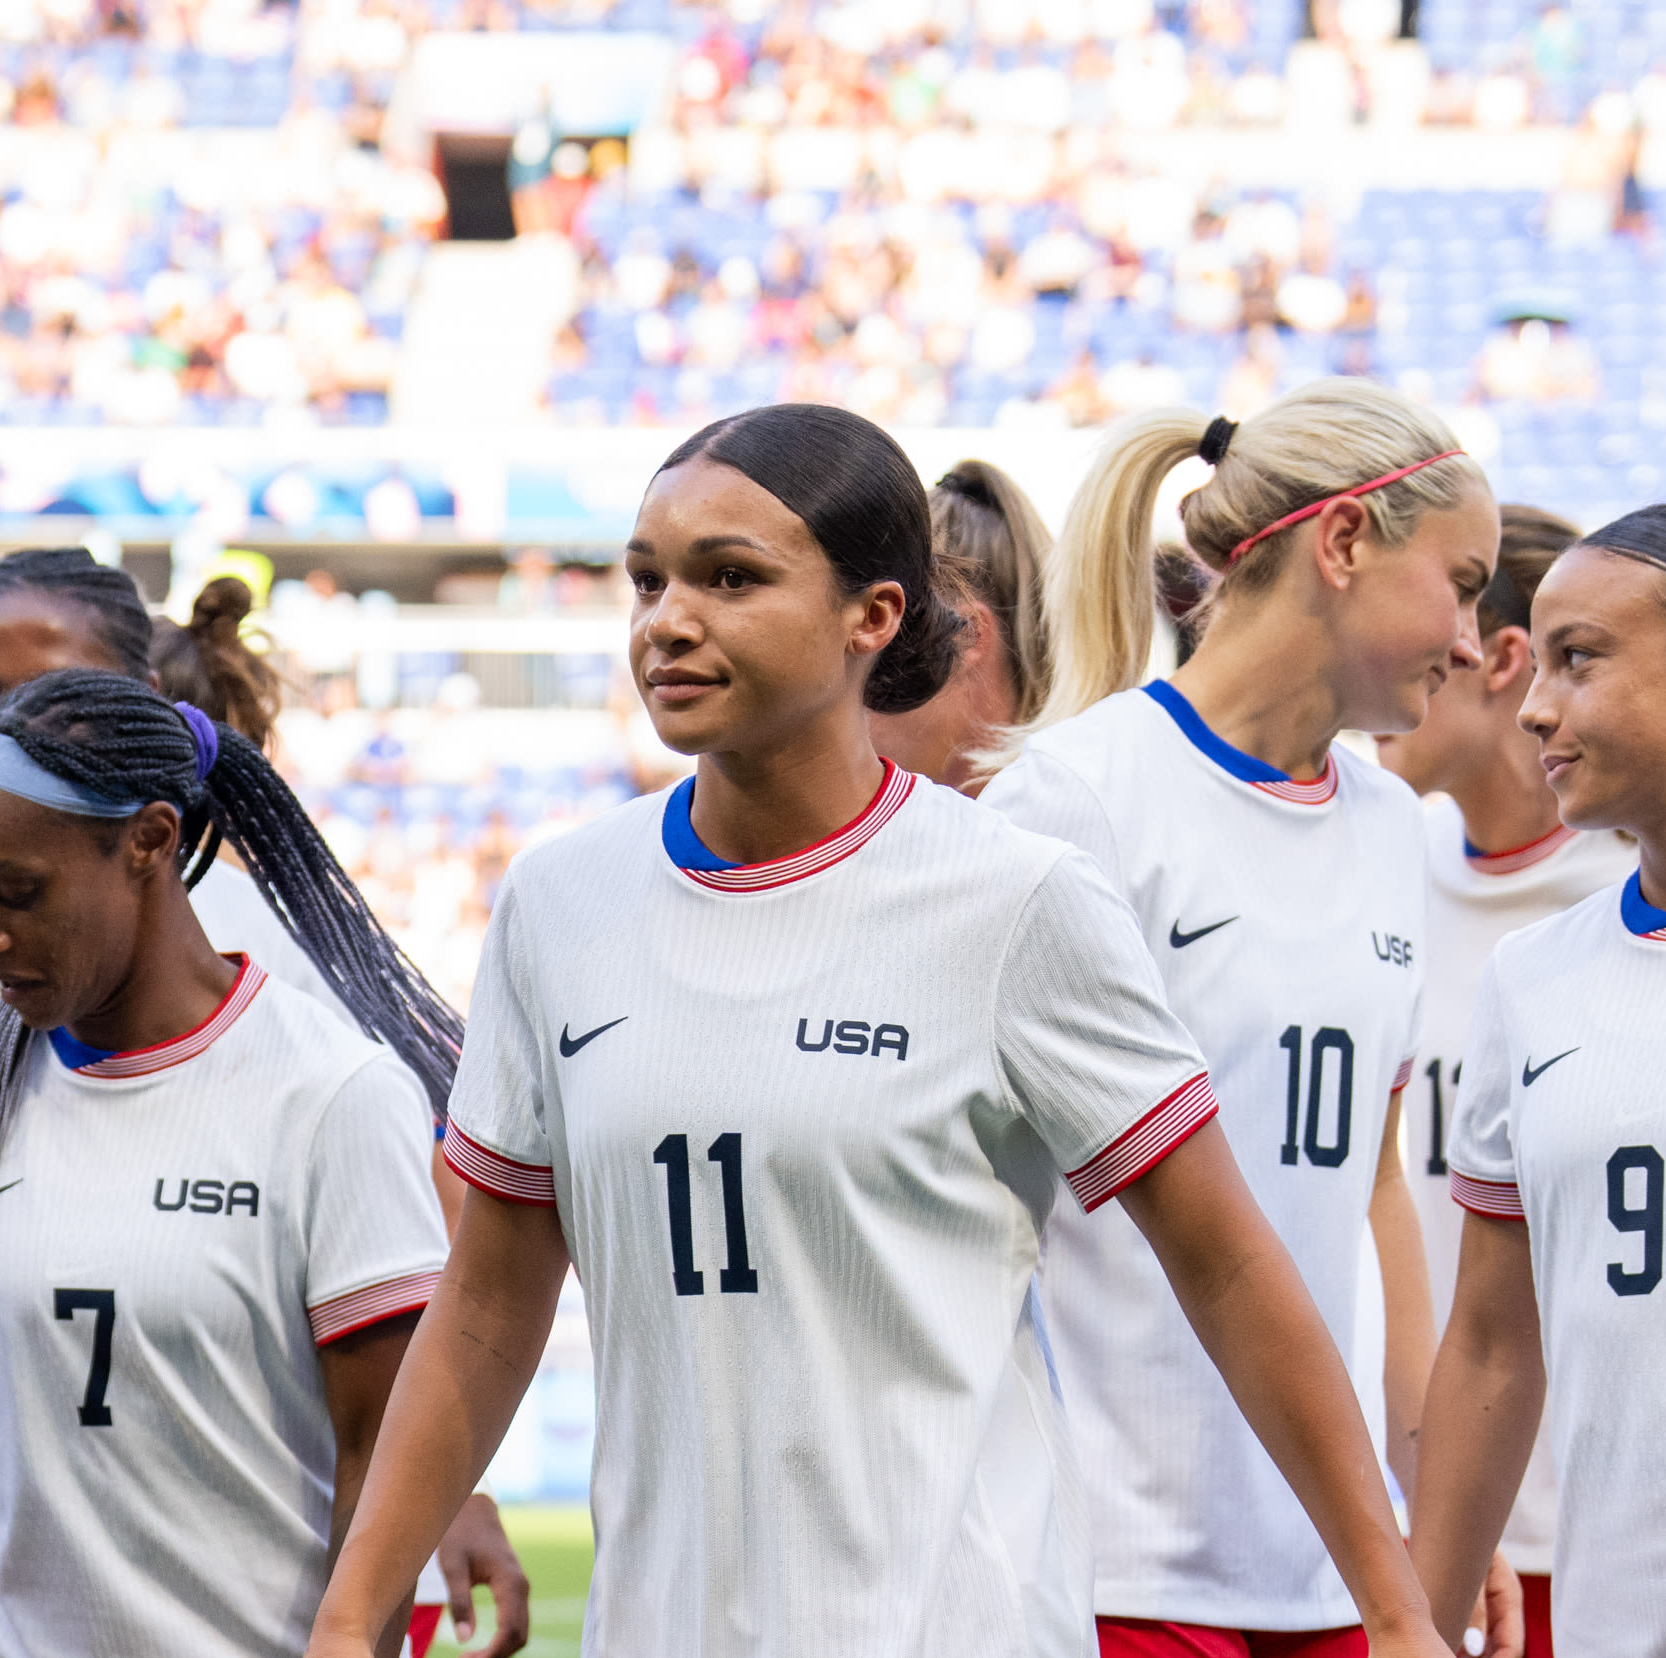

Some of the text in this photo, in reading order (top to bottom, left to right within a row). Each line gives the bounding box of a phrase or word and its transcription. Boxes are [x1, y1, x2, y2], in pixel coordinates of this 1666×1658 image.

[1372, 930, 1413, 969] USA
[796, 1018, 910, 1061] USA
[1279, 1025, 1354, 1169] 10
[1426, 1058, 1463, 1176] 1
[154, 1179, 260, 1217] USA
[653, 1132, 759, 1297] 11
[1605, 1145, 1665, 1297] 9
[53, 1288, 117, 1428] 7
